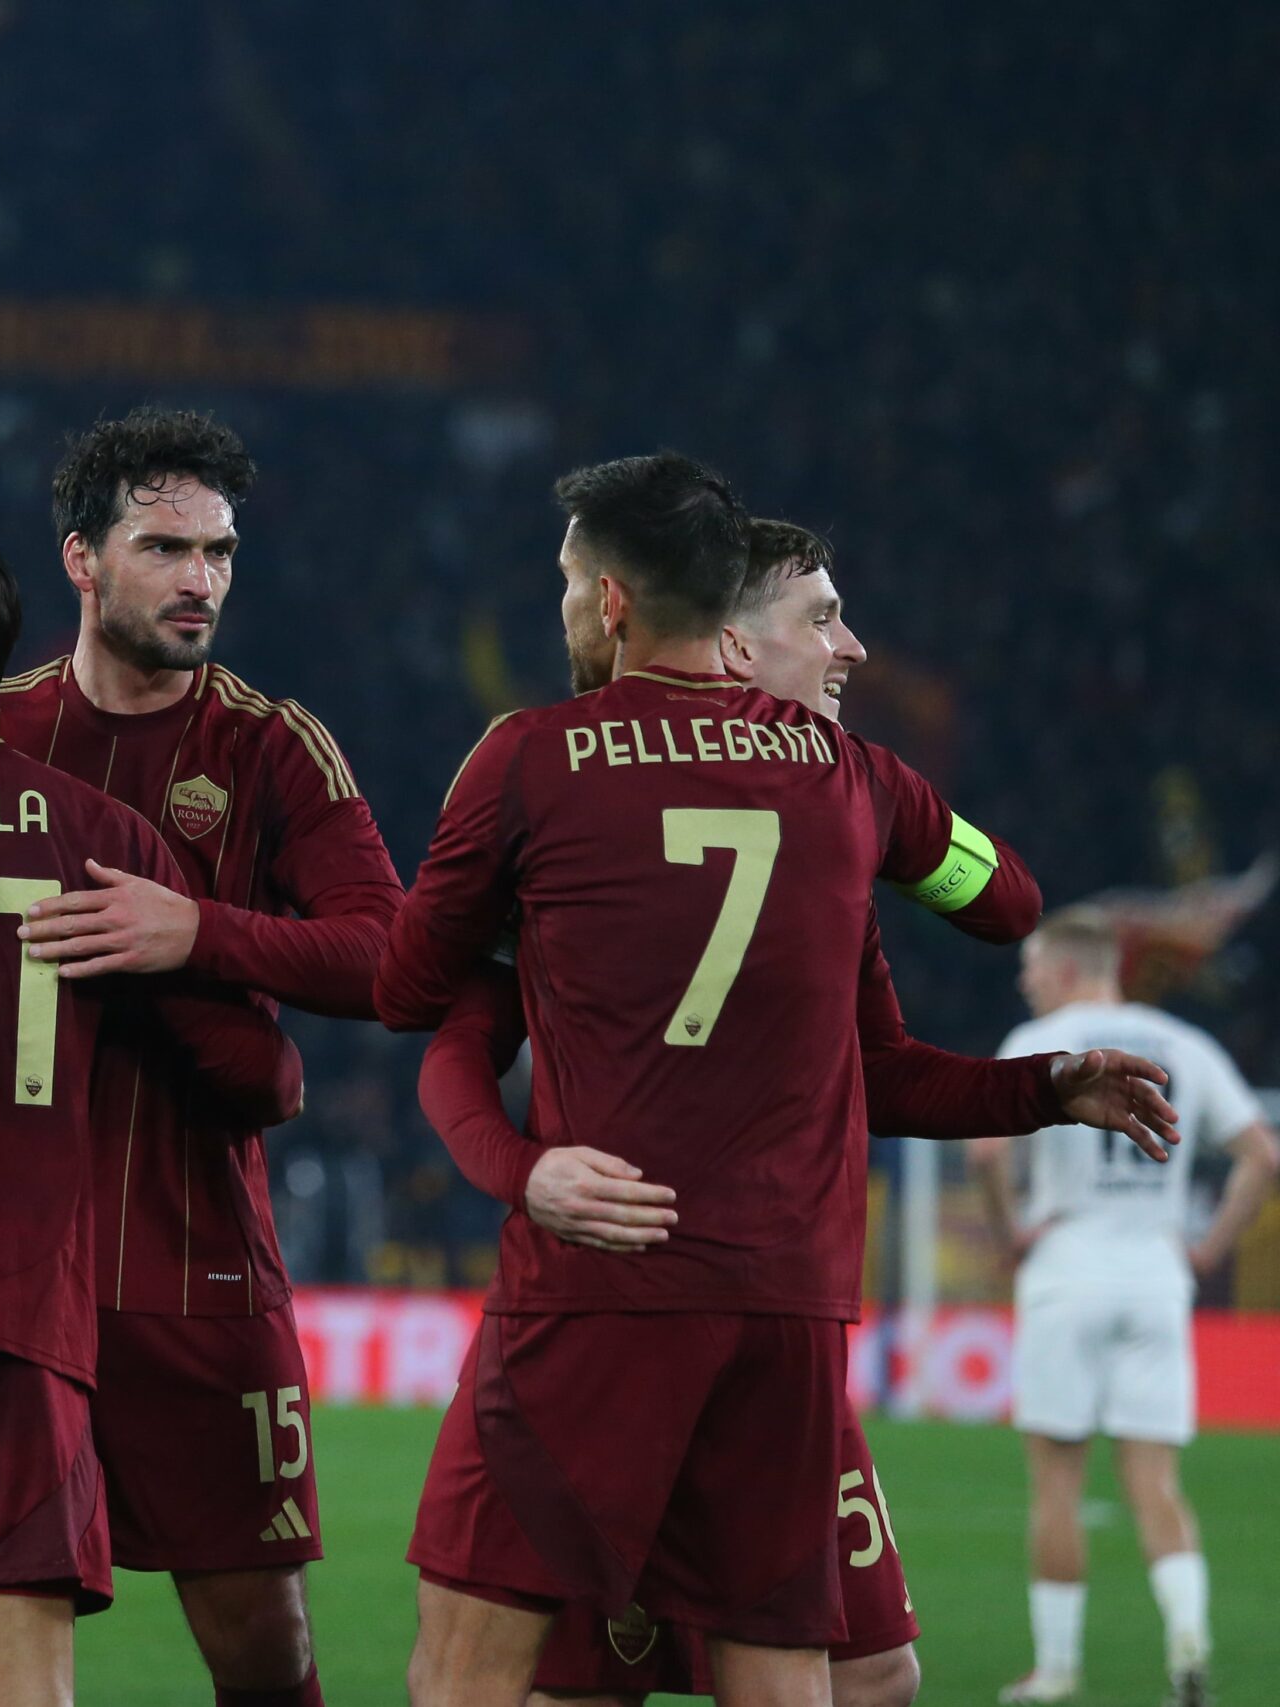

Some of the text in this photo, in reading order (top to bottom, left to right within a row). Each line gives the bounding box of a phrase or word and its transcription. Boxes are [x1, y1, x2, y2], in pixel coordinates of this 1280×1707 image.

[177, 809, 212, 823] ROMA
[921, 864, 967, 901] SPECT
[663, 808, 781, 1047] 7
[242, 1385, 308, 1483] 15
